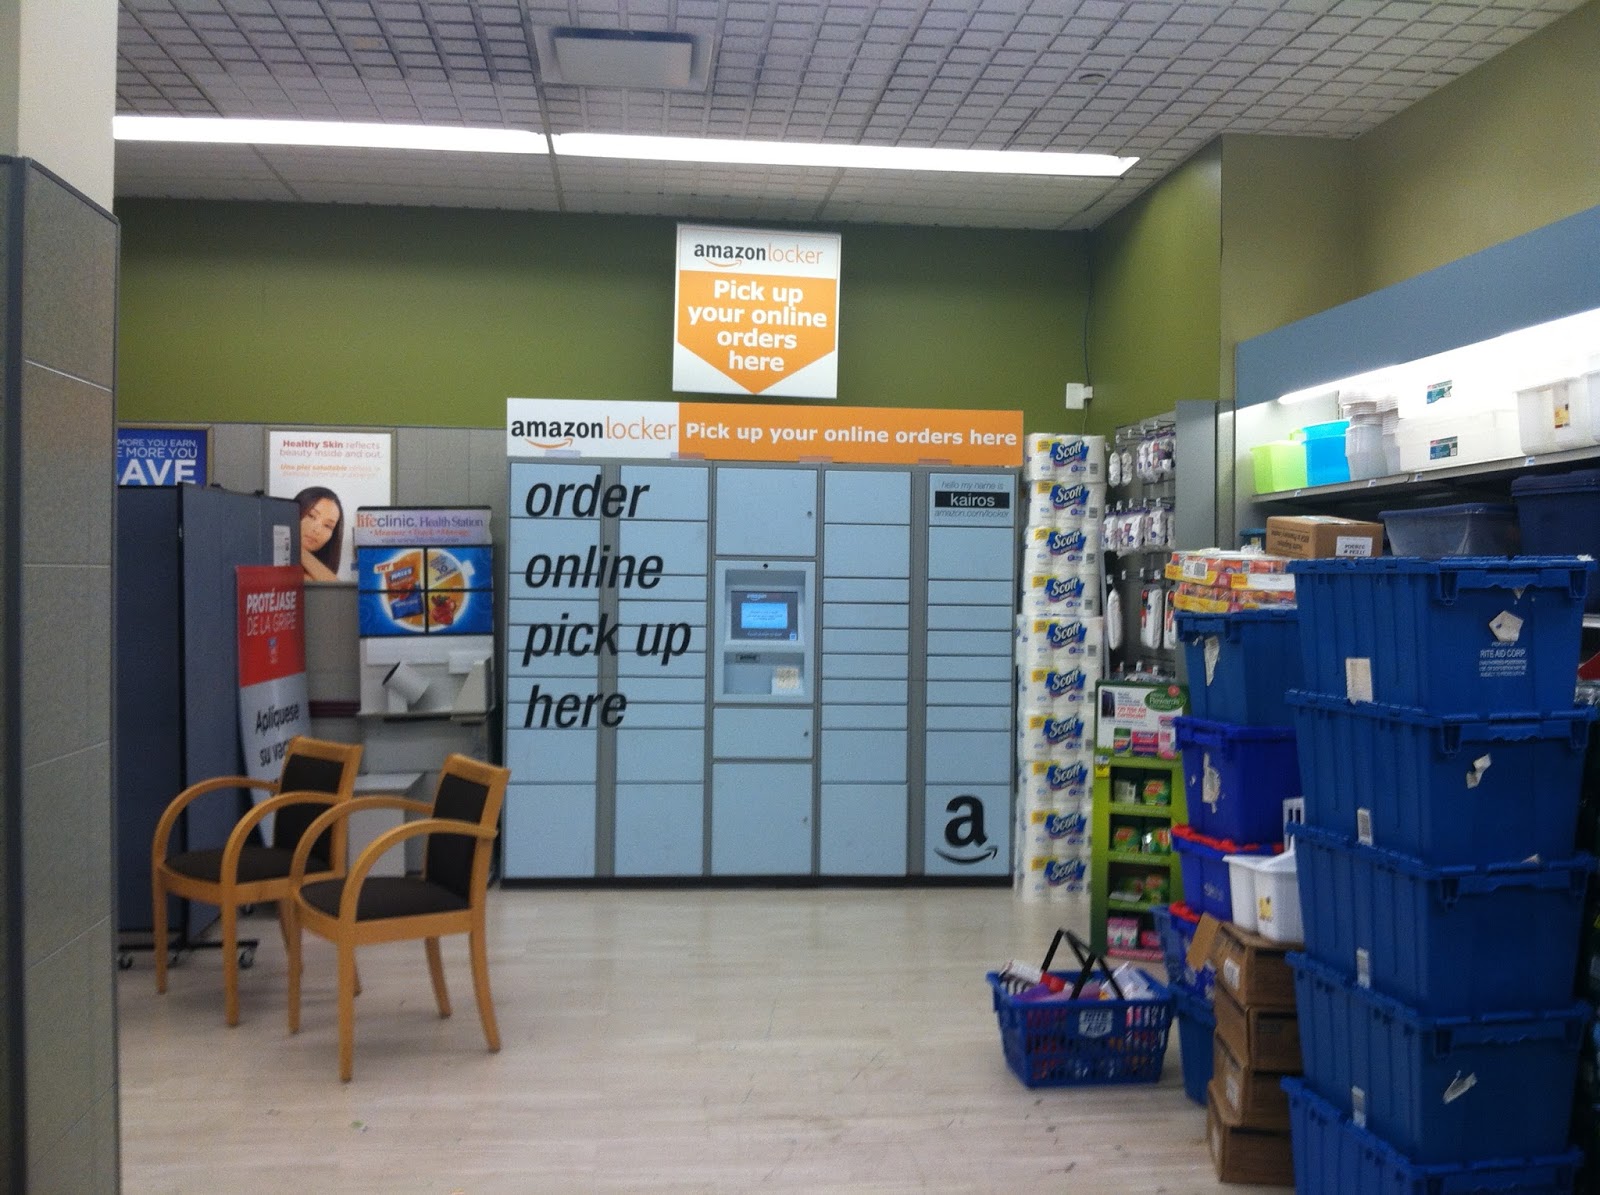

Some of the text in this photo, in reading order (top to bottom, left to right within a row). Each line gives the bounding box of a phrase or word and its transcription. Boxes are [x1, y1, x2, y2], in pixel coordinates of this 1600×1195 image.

[713, 279, 803, 306] Pick up
[687, 306, 827, 328] your online
[717, 328, 797, 349] orders
[728, 350, 784, 372] here
[147, 439, 168, 447] YOU
[283, 439, 380, 450] Healthy Skin reflects
[685, 422, 729, 439] Pick
[737, 426, 763, 443] up
[769, 427, 818, 444] your
[824, 426, 889, 443] online
[895, 428, 963, 444] orders
[970, 429, 1017, 446] here
[126, 447, 165, 458] MORE
[168, 447, 198, 458] YOU
[280, 448, 312, 457] beauty
[315, 449, 342, 457] inside
[345, 450, 362, 458] and
[1055, 440, 1084, 461] Scott
[117, 458, 197, 486] AVE
[525, 474, 650, 518] order
[960, 482, 974, 490] my
[1055, 484, 1084, 504] Scott
[951, 492, 995, 507] kairos
[419, 516, 450, 528] Health
[451, 515, 484, 527] Station
[1052, 530, 1081, 550] Scott
[525, 545, 664, 589] online
[1051, 577, 1079, 597] Scott
[246, 588, 297, 615] PROTÉJASE
[522, 613, 692, 667] pick up
[1052, 621, 1081, 642] Scott
[1051, 668, 1080, 691] Scott
[523, 684, 627, 728] here
[1049, 716, 1078, 737] Scott
